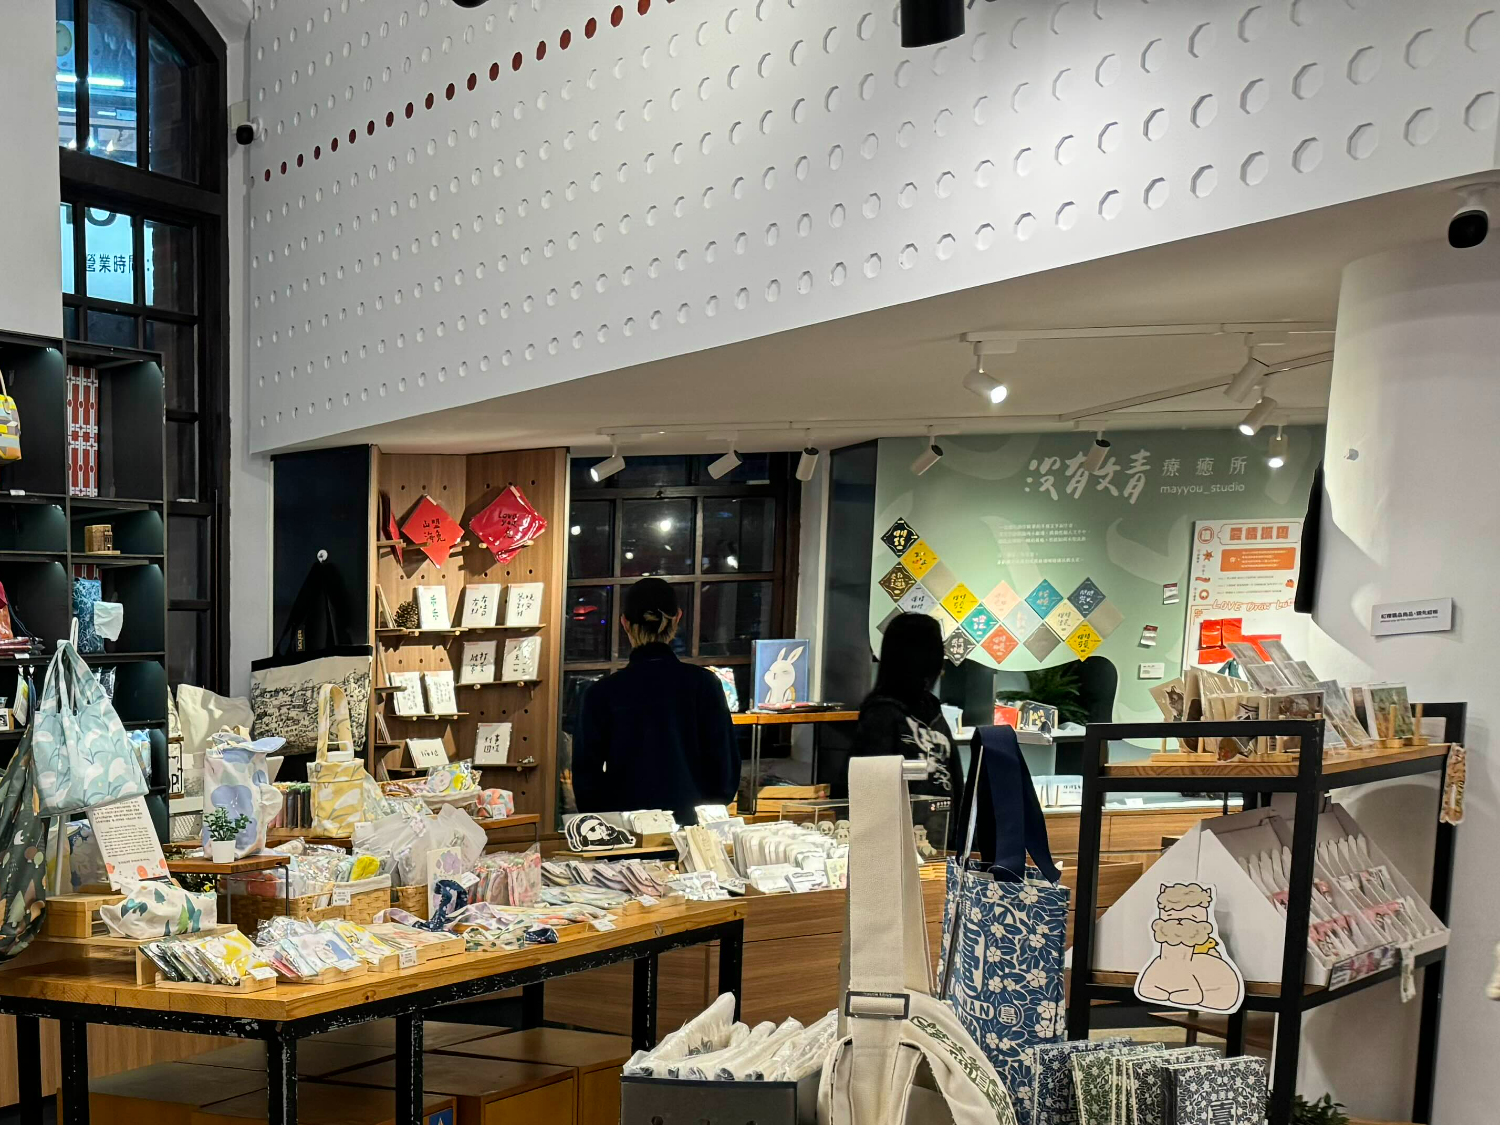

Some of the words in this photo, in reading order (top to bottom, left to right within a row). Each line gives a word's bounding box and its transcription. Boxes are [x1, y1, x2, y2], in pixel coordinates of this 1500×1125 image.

[1161, 455, 1248, 478] 療癒所
[1160, 481, 1246, 496] mayyou_studio
